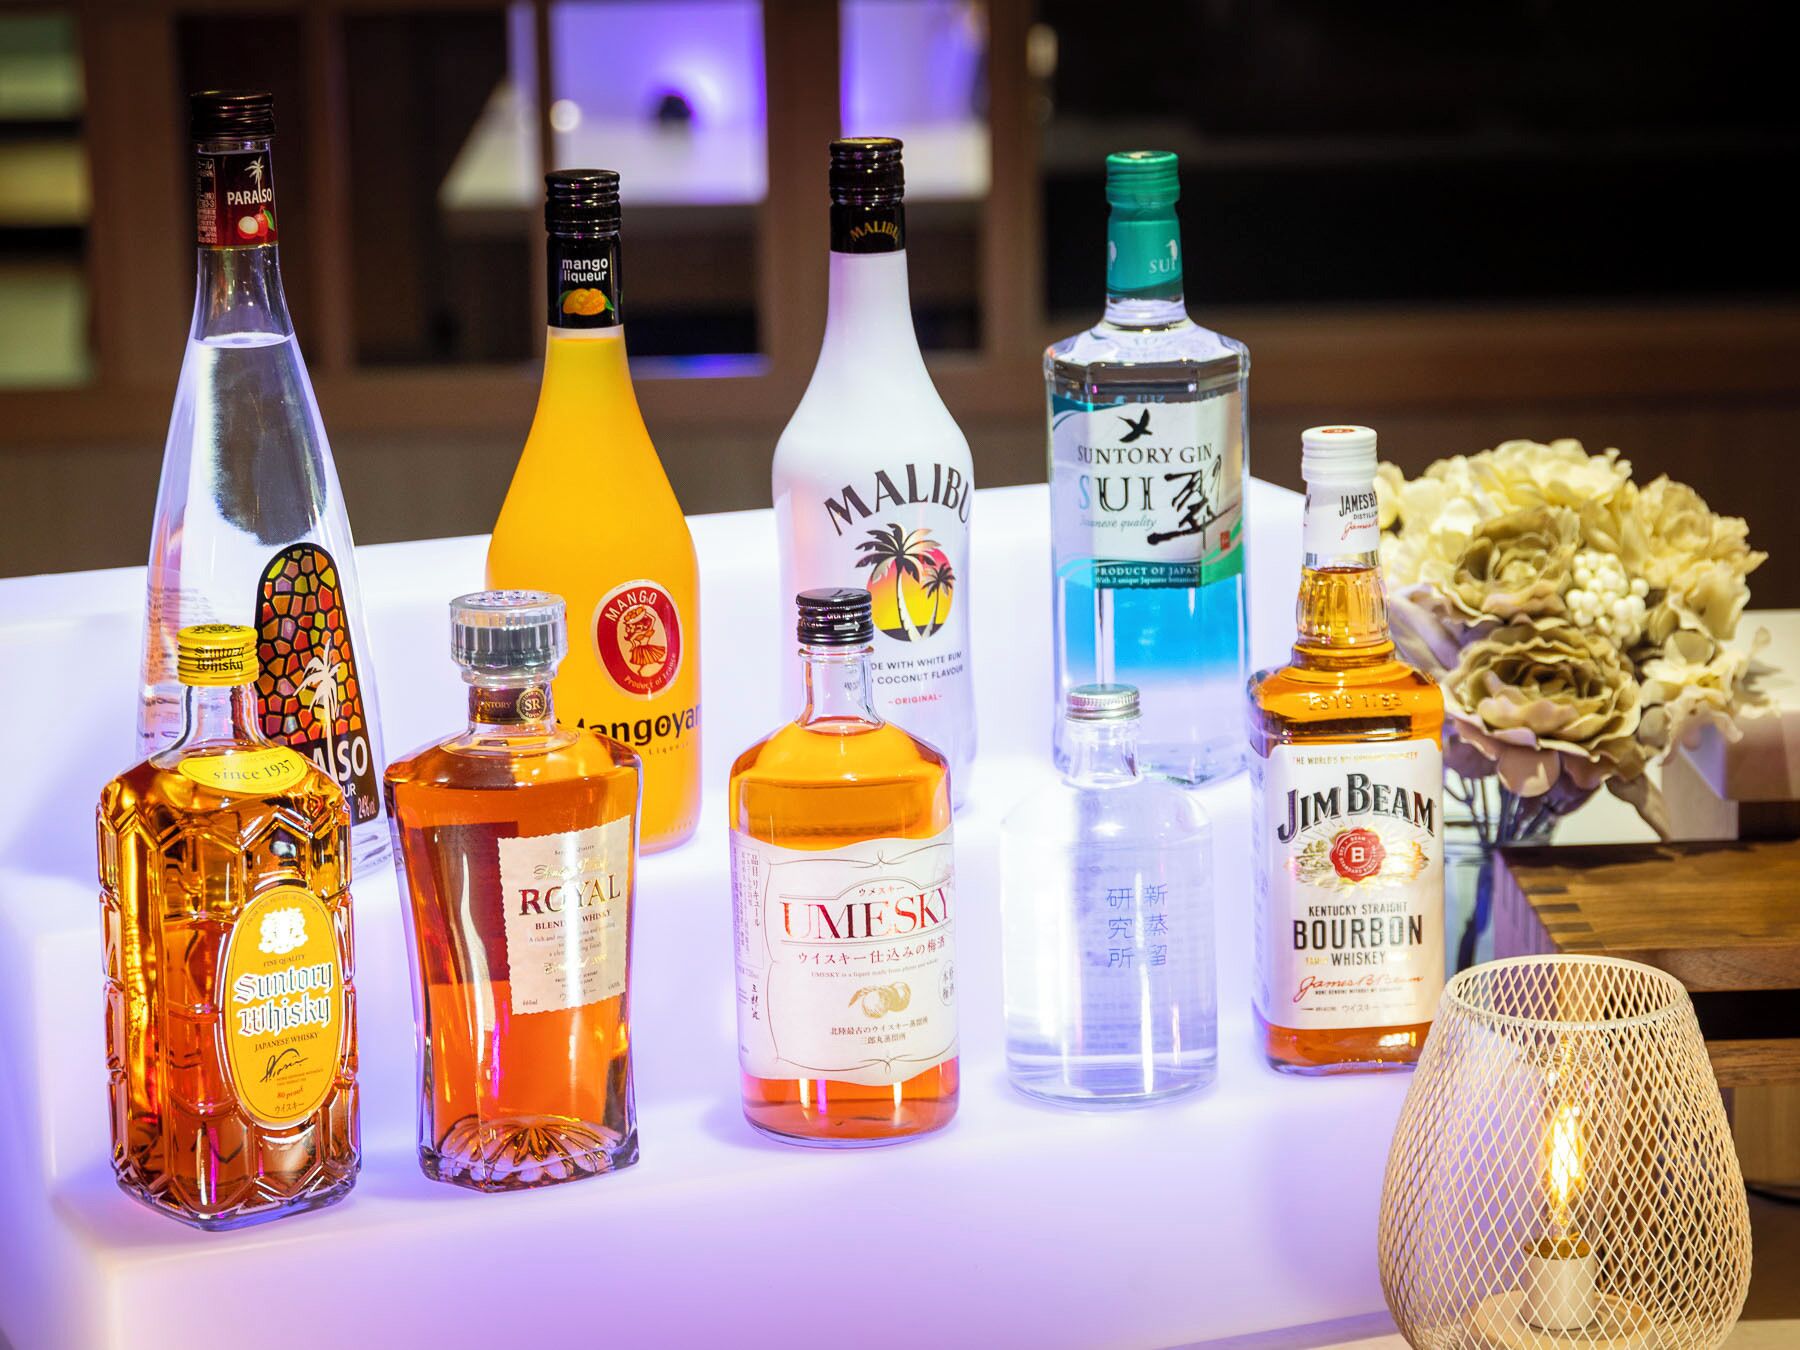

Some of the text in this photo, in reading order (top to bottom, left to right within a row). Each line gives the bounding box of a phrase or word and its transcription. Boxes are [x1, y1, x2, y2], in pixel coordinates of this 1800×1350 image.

[227, 187, 272, 206] PARAISO
[562, 258, 608, 271] mango
[1149, 258, 1176, 274] SUI
[564, 270, 607, 283] liqueur
[1078, 442, 1213, 464] SUNTORY GIN
[1079, 474, 1155, 512] SUI
[1339, 494, 1369, 517] JAMES
[1120, 514, 1157, 533] quality
[1096, 565, 1199, 577] PRODUCT OF JAPAN
[605, 589, 658, 622] MANGO
[887, 658, 914, 671] WITH
[917, 655, 944, 668] WHITE
[877, 672, 928, 685] COCONUT
[524, 698, 541, 711] SR
[894, 693, 938, 706] ORIGINAL
[213, 759, 296, 781] since 1937
[1277, 773, 1435, 844] JIM BEAM
[1351, 846, 1365, 863] B
[518, 873, 622, 917] ROYAL
[1308, 902, 1408, 918] KENTUCKY STRAIGHT
[1106, 887, 1135, 969] 研究所
[1144, 883, 1169, 967] 新蒸留
[1292, 914, 1423, 951] BOURBON
[1331, 951, 1387, 967] WHISKEY
[234, 962, 333, 1002] Suntory
[238, 994, 331, 1036] Whisky
[254, 1031, 319, 1053] JAPANESE WHISKY
